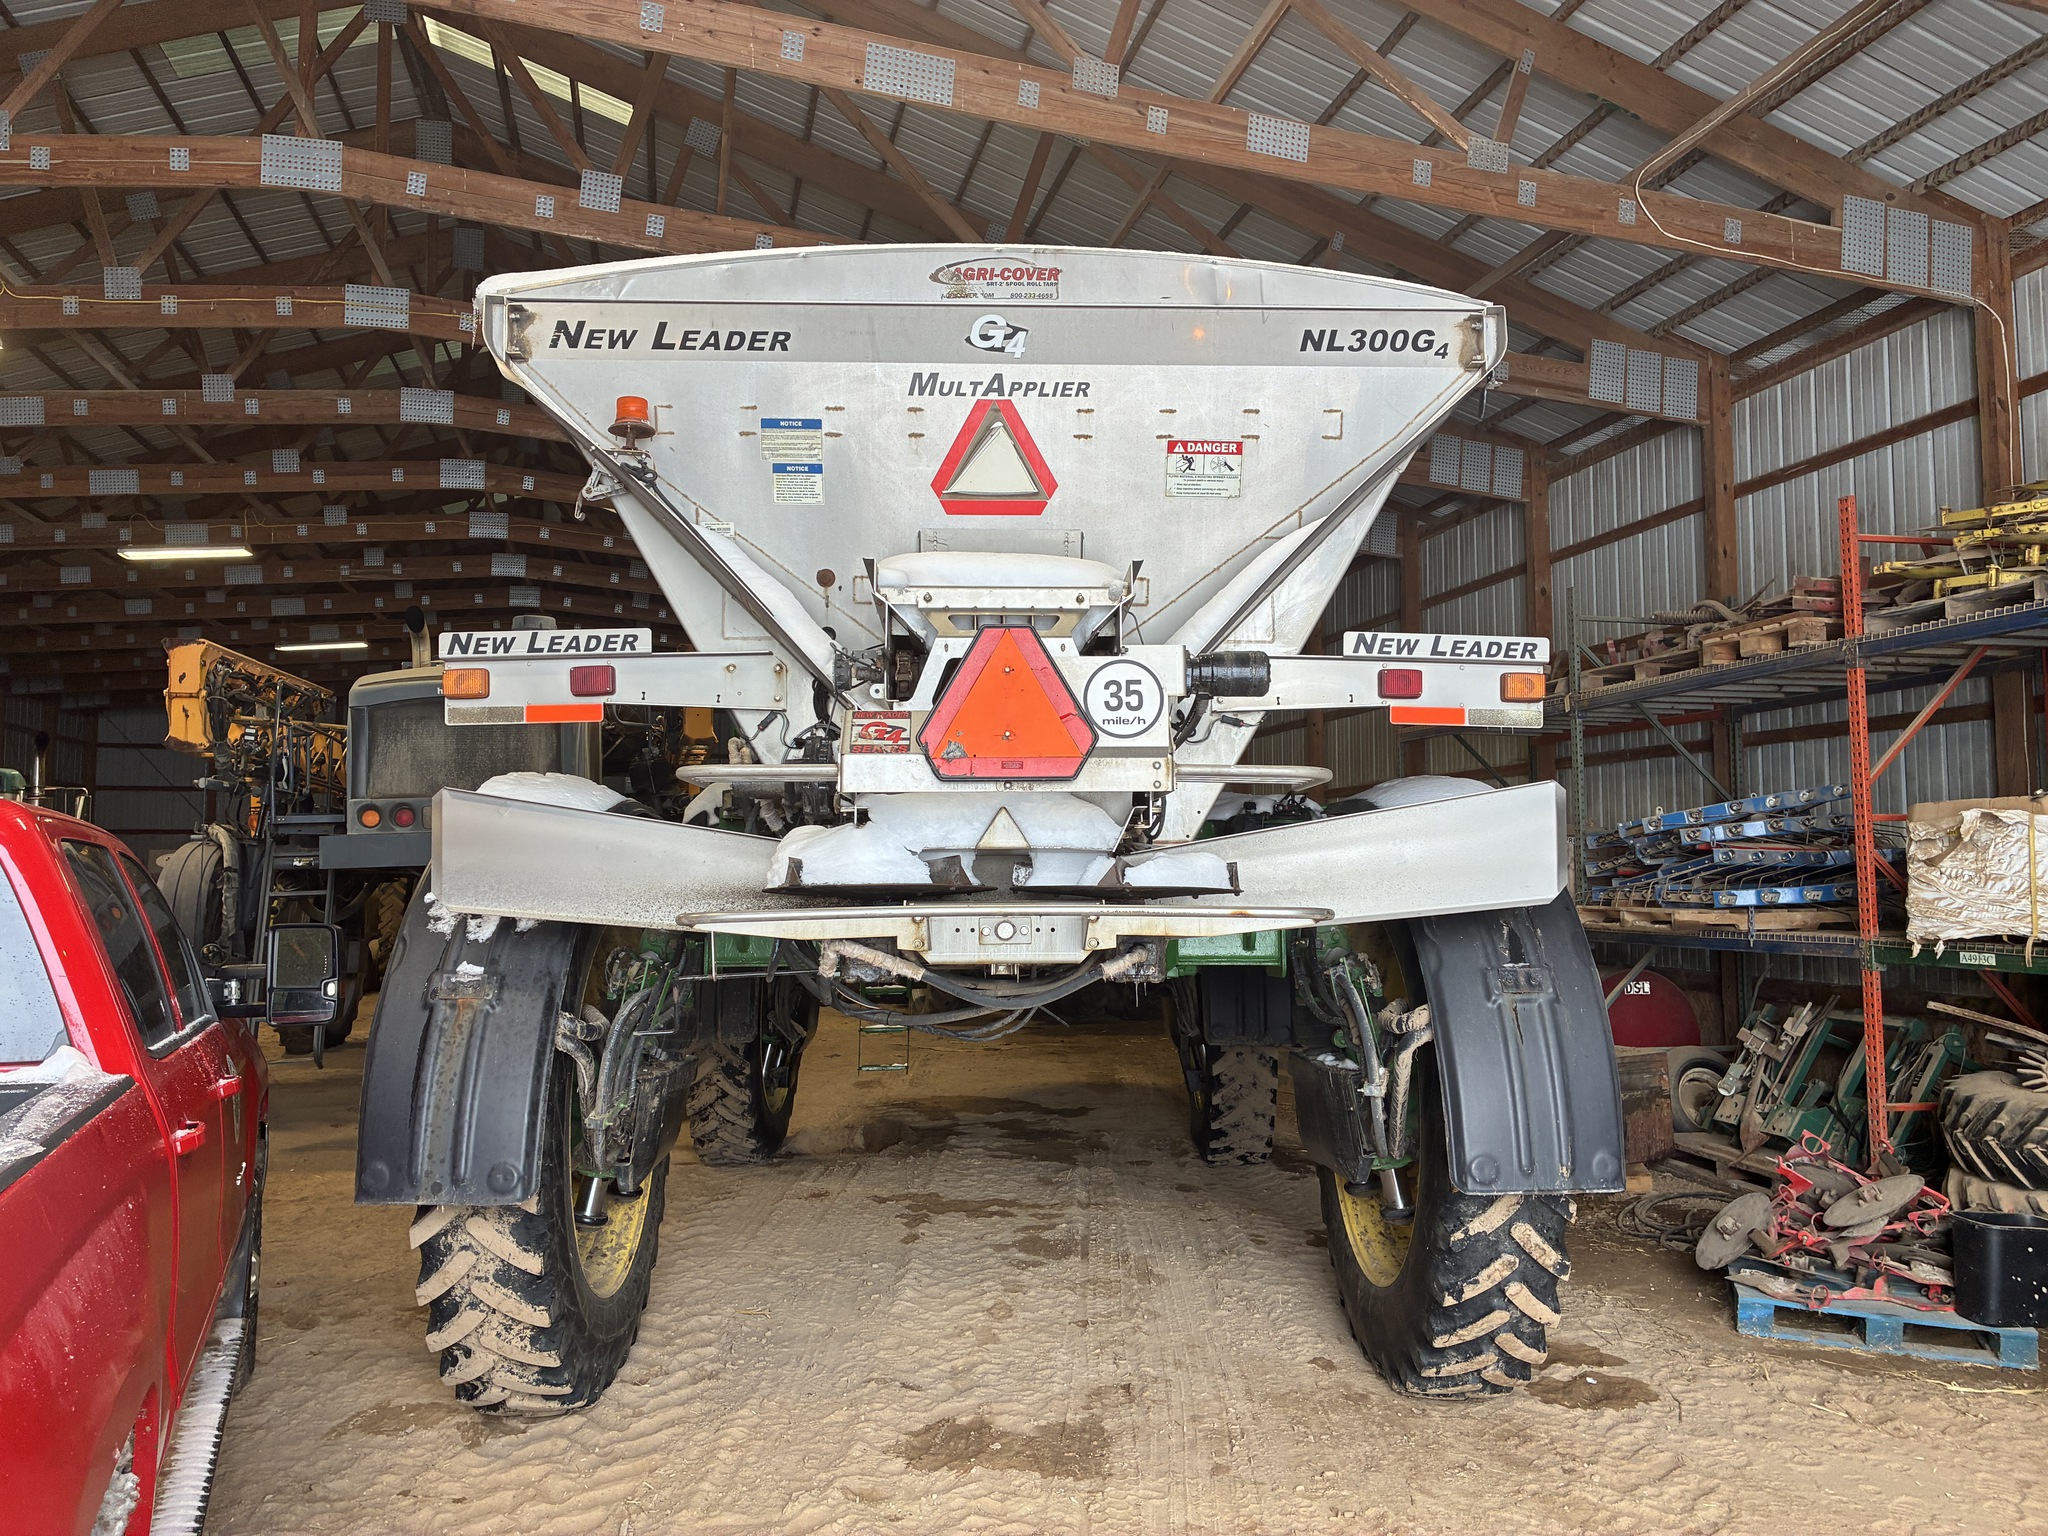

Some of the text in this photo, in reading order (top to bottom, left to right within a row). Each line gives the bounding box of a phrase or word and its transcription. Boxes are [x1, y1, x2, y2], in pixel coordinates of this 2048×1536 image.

[1187, 442, 1237, 453] DANGER
[1103, 680, 1143, 712] 35
[1102, 716, 1146, 725] mile/h
[1626, 982, 1650, 994] DSL
